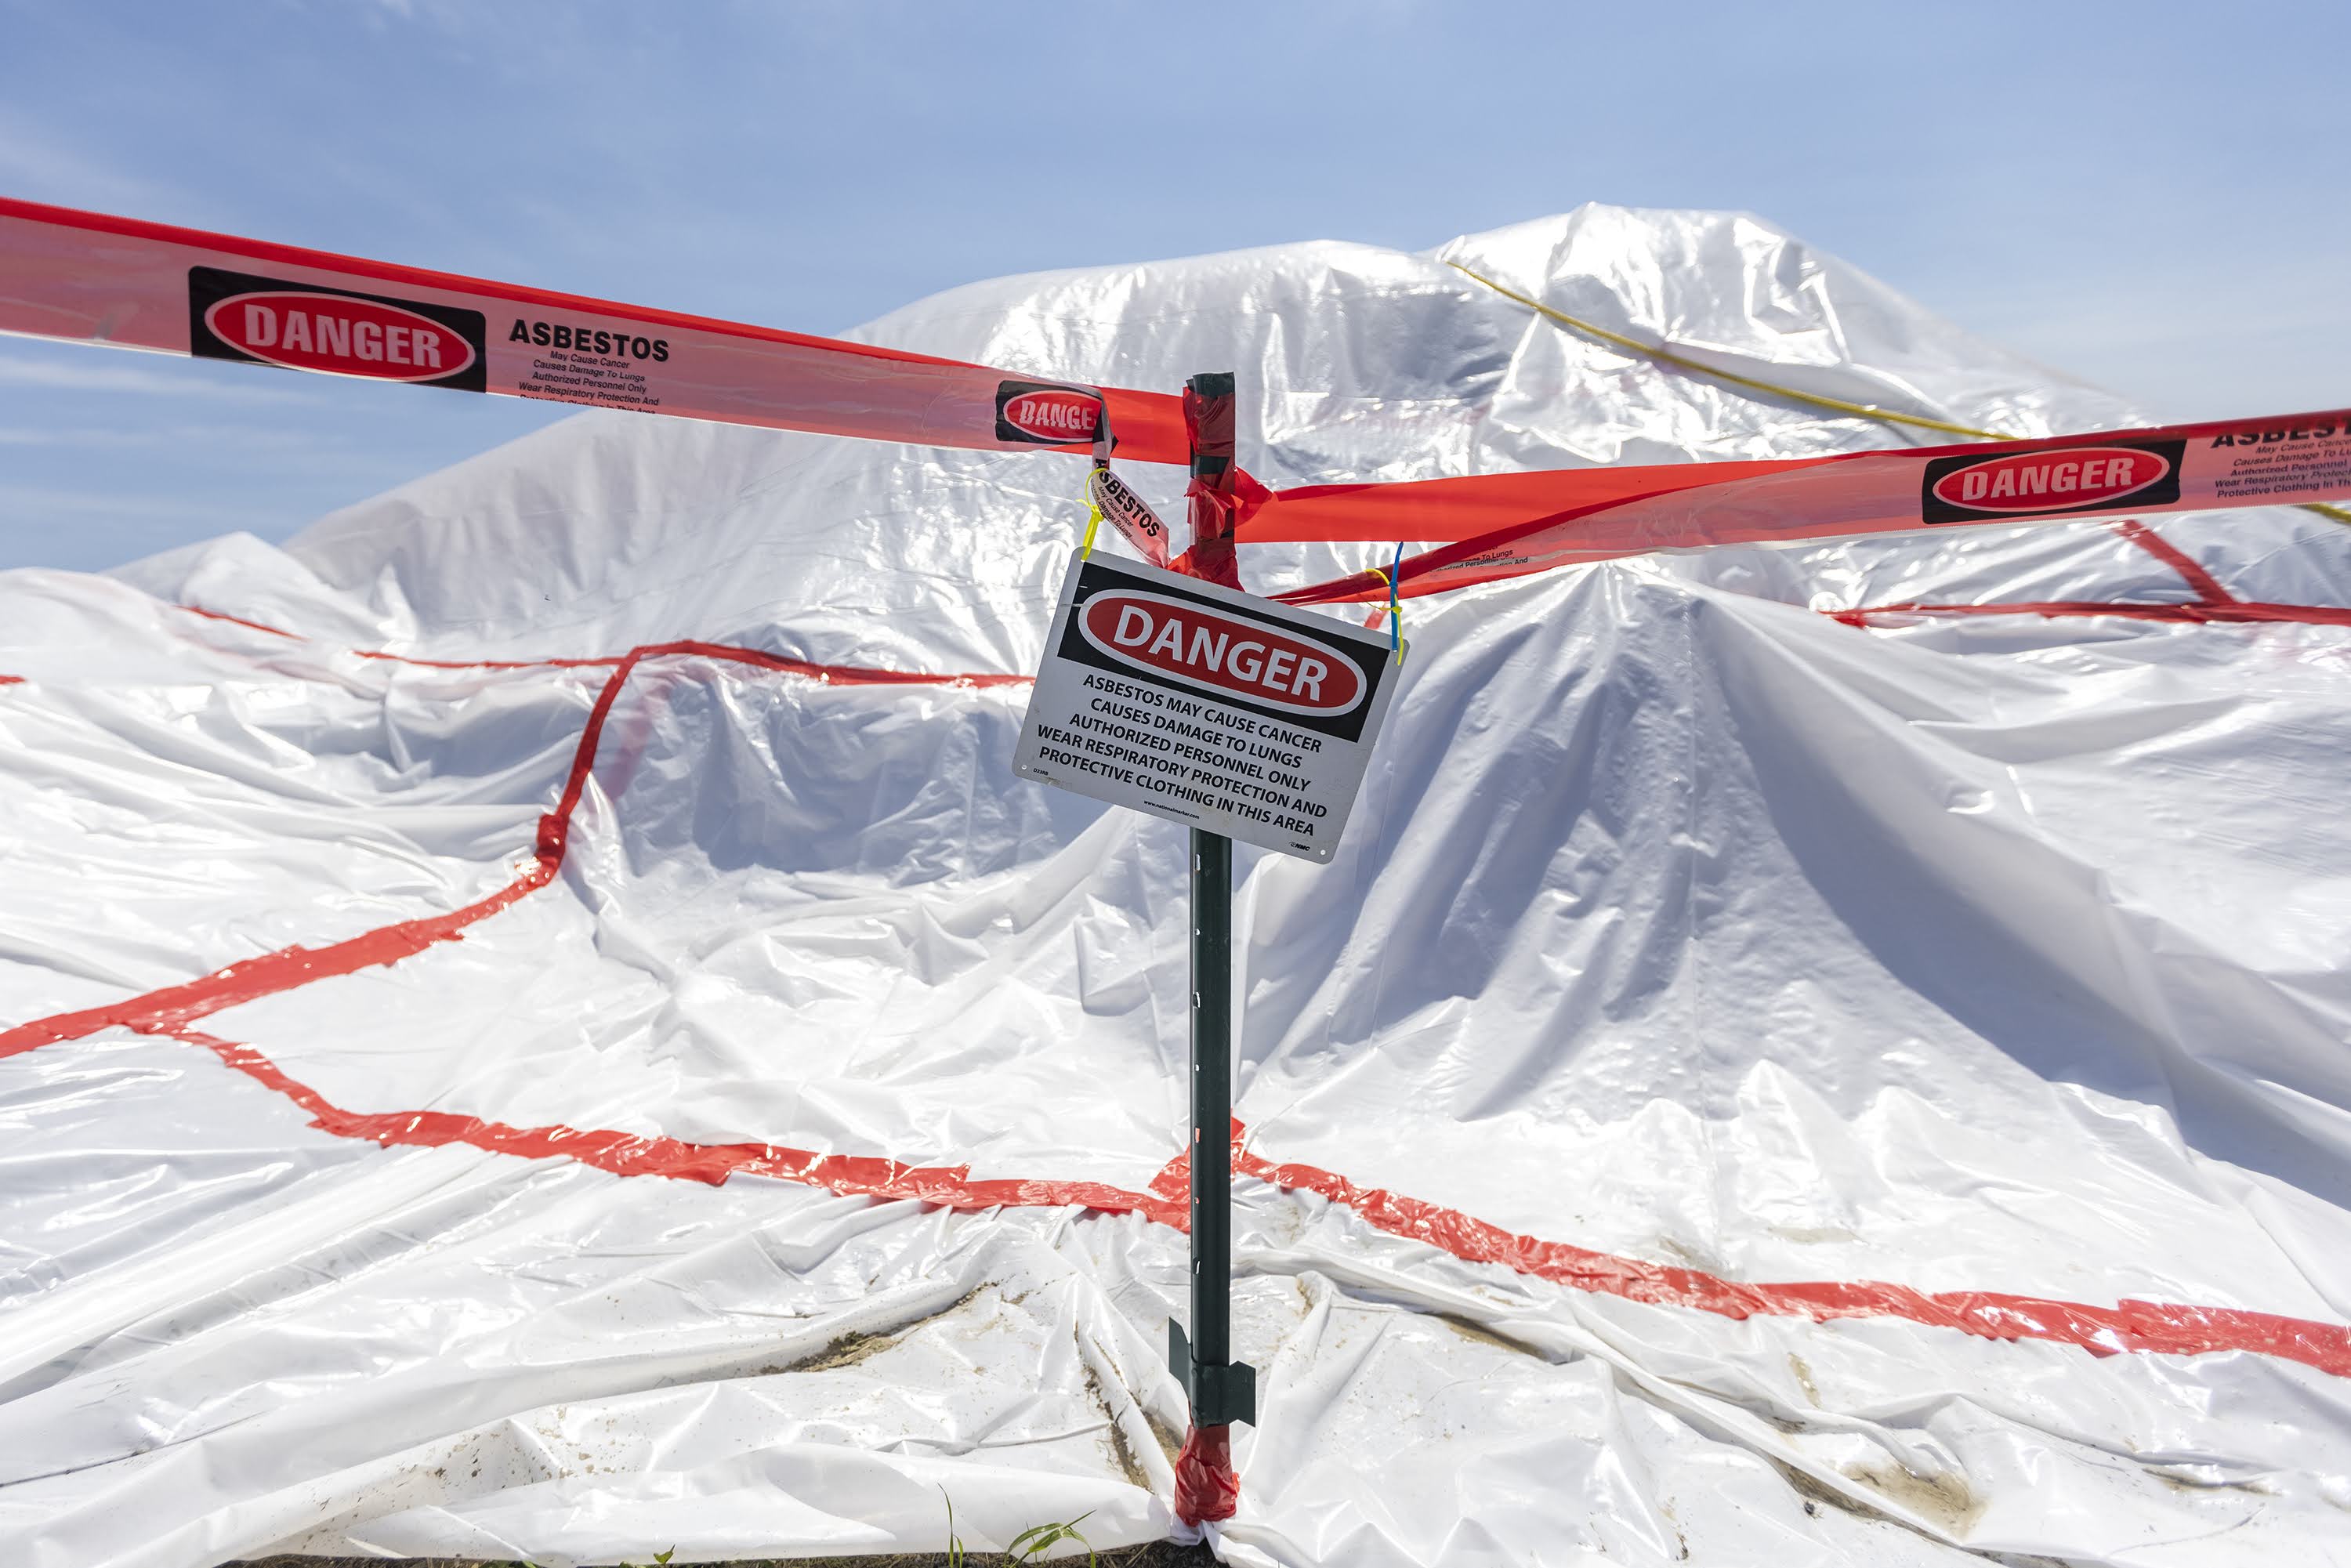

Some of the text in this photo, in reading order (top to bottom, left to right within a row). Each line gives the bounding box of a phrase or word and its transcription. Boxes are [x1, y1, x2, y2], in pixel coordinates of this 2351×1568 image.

[245, 304, 441, 368] DANGER
[509, 319, 669, 362] ASBESTOS
[533, 359, 646, 382] Causes Damage To Lungs
[550, 350, 630, 368] May Cause Cancer
[518, 381, 542, 393] Wear
[544, 384, 595, 400] Respiratory
[597, 392, 640, 404] Protection
[642, 397, 659, 406] And
[531, 371, 647, 395] Authorized Personnel Only
[1020, 400, 1096, 430] DANGE
[2255, 446, 2279, 454] May
[2280, 443, 2315, 452] Cause
[2275, 452, 2320, 462] Damage
[2323, 449, 2336, 458] To
[1962, 457, 2135, 501] DANGER
[2231, 459, 2347, 476] Authorized Personnel
[2244, 473, 2309, 484] Respiratory
[2217, 486, 2270, 498] Protective
[2273, 482, 2320, 494] Clothing
[1098, 486, 1107, 498] May
[1106, 498, 1121, 514] Cause
[1118, 511, 1134, 527] Cancer
[1099, 501, 1116, 521] Damage
[1114, 519, 1121, 527] To
[1119, 524, 1133, 538] Lungs
[1492, 549, 1513, 559] Lungs
[1514, 556, 1528, 565] And
[1113, 604, 1328, 701] DANGER
[1082, 674, 1322, 754] ASBESTOS MAY CAUSE CANCER
[1090, 697, 1303, 769] CAUSES DAMAGE TO LUNGS
[1068, 713, 1312, 792] AUTHORIZED PERSONNEL ONLY
[1038, 723, 1328, 818] WEAR RESPIRATORY PROTECTION AND
[1038, 745, 1314, 837] PROTECTIVE CLOTHING IN THIS AREA
[1143, 800, 1200, 820] www.nationalmarker.com
[1294, 842, 1310, 851] NMC
